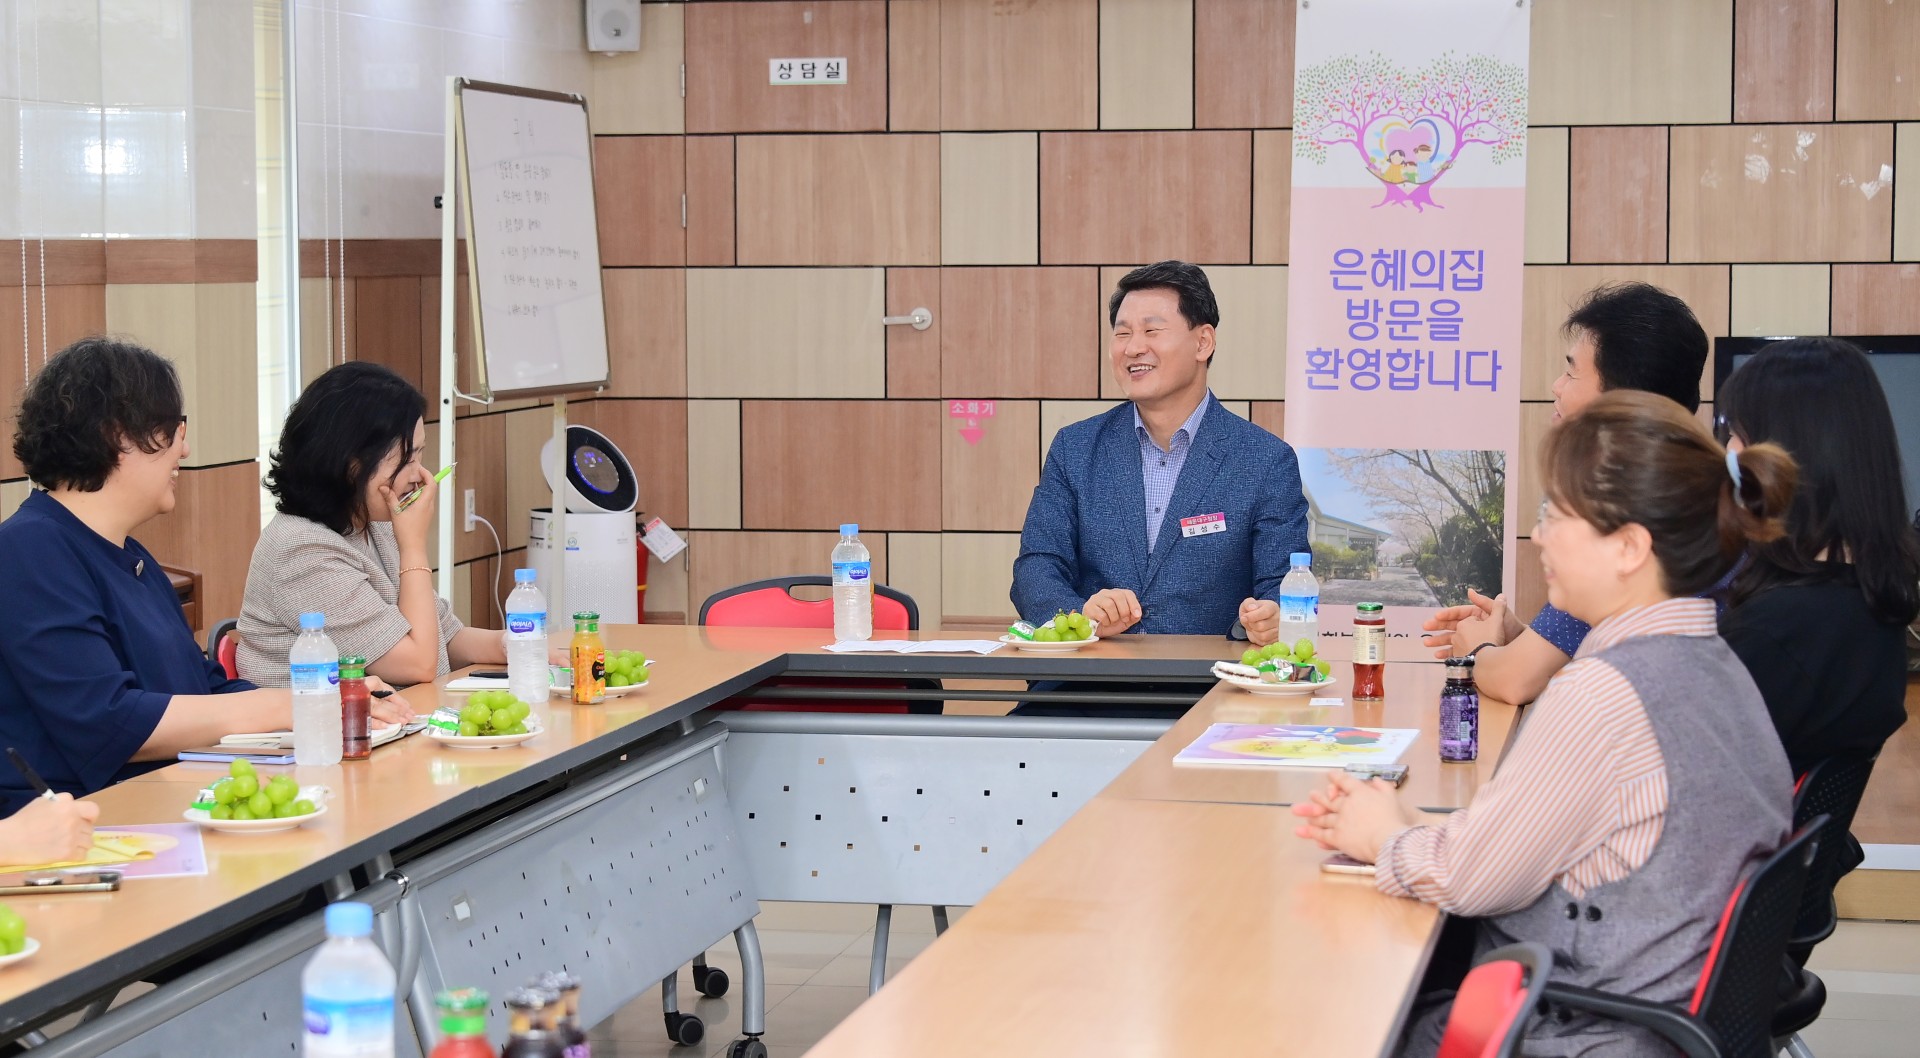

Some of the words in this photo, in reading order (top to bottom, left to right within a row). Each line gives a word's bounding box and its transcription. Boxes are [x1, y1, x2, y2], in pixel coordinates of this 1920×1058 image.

[778, 62, 840, 80] 상담실
[1329, 248, 1484, 292] 은혜의집
[1346, 298, 1464, 342] 방문을
[1304, 347, 1503, 392] 환영합니다
[951, 402, 993, 416] 소화기
